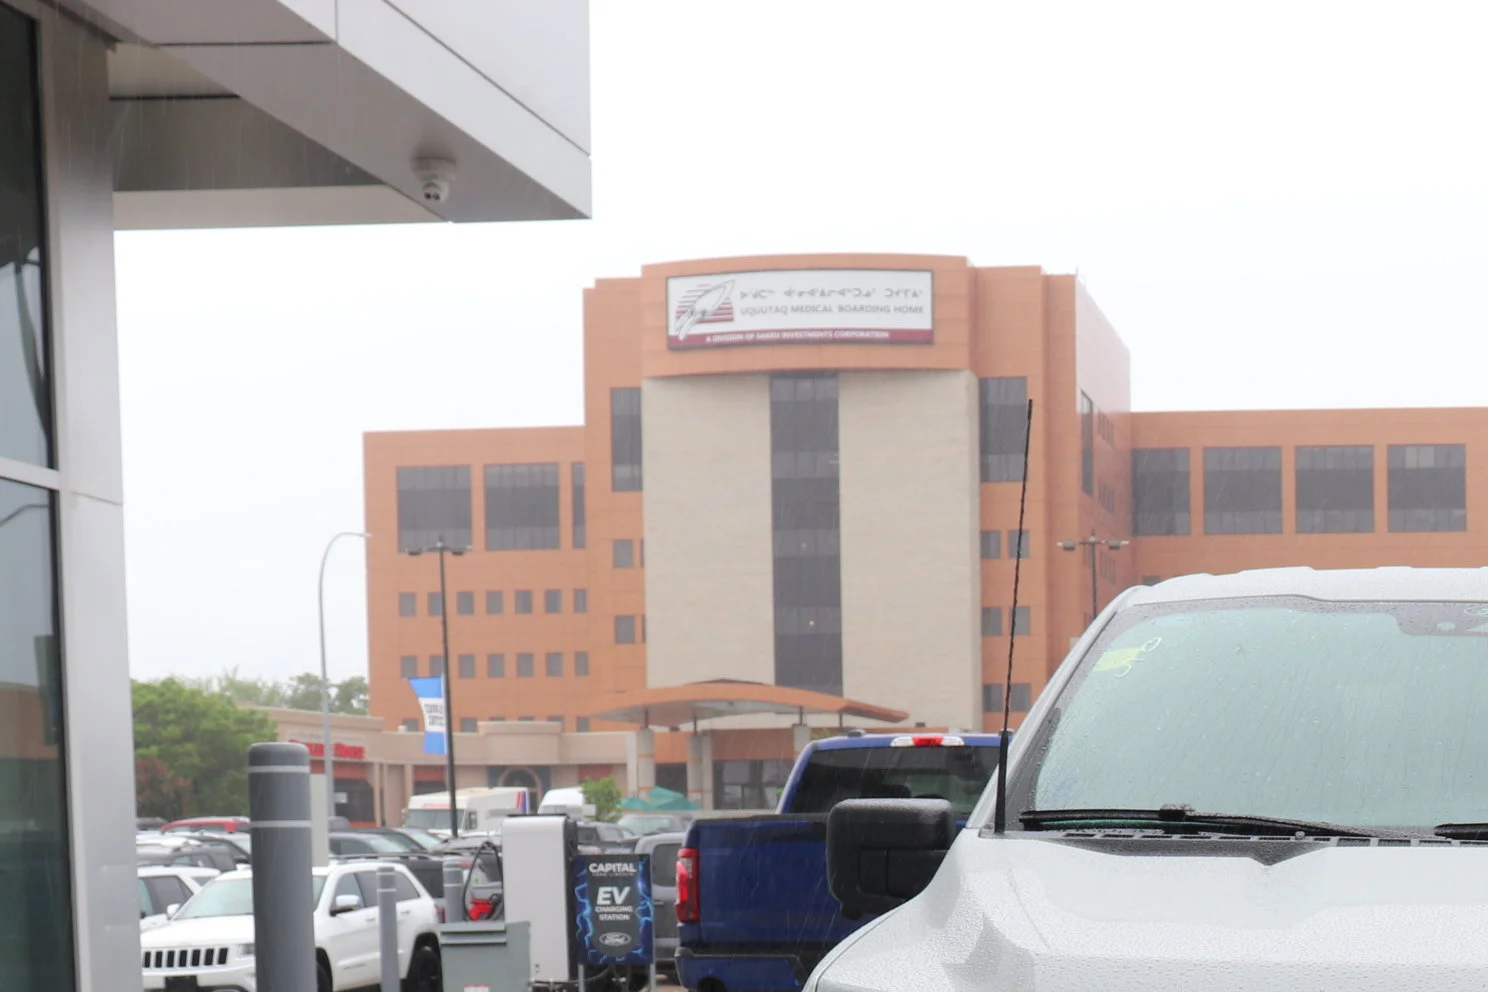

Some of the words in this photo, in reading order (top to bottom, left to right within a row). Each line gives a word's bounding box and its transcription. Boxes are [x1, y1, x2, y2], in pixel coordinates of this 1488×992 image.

[790, 304, 833, 313] MEDICAL
[838, 304, 890, 313] BOARDING
[894, 304, 923, 313] HOME
[589, 862, 637, 873] CAPITAL
[597, 886, 631, 905] EV
